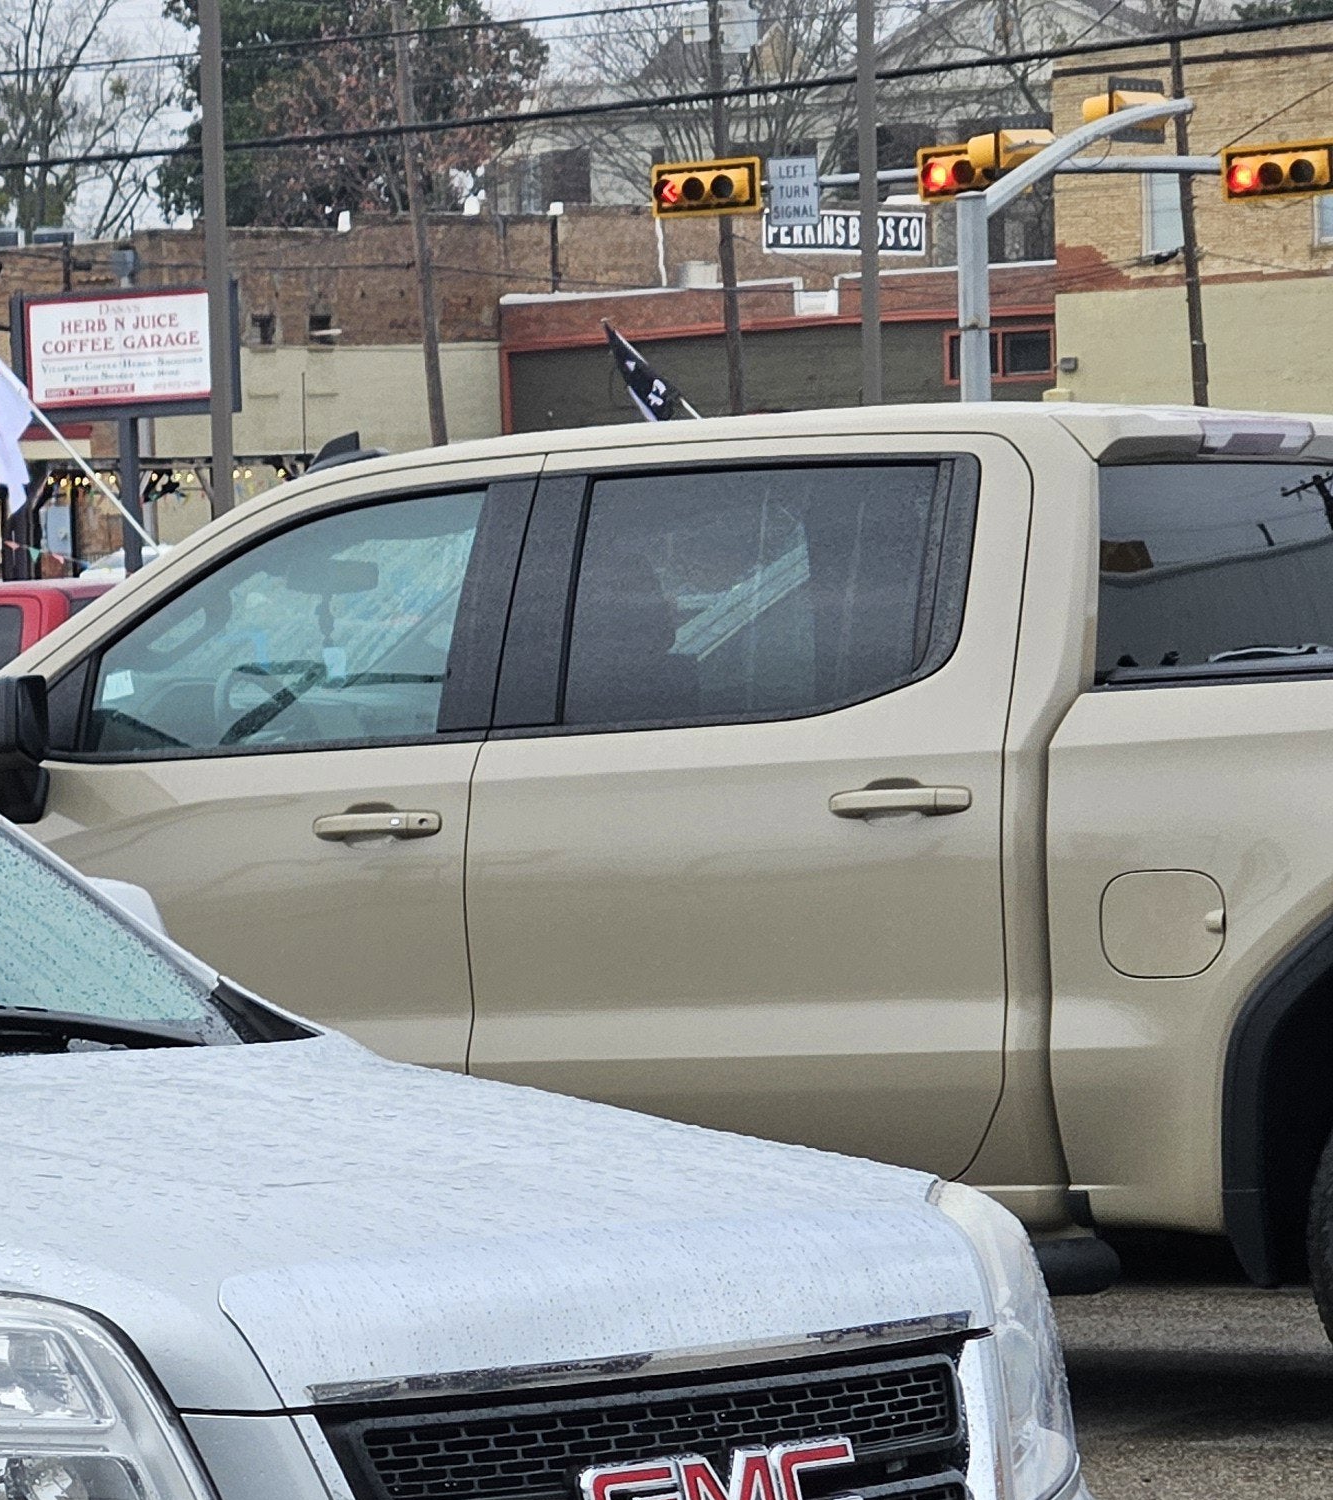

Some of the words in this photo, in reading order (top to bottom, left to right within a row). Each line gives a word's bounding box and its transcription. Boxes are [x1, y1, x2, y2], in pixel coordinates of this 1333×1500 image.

[778, 164, 806, 179] LEFT
[779, 185, 810, 199] TURN
[773, 205, 816, 220] SIGNAL
[60, 318, 107, 335] HERB
[114, 317, 126, 331] N
[132, 313, 179, 330] JUICE
[42, 337, 115, 355] COFFEE
[123, 331, 200, 350] GARAGE
